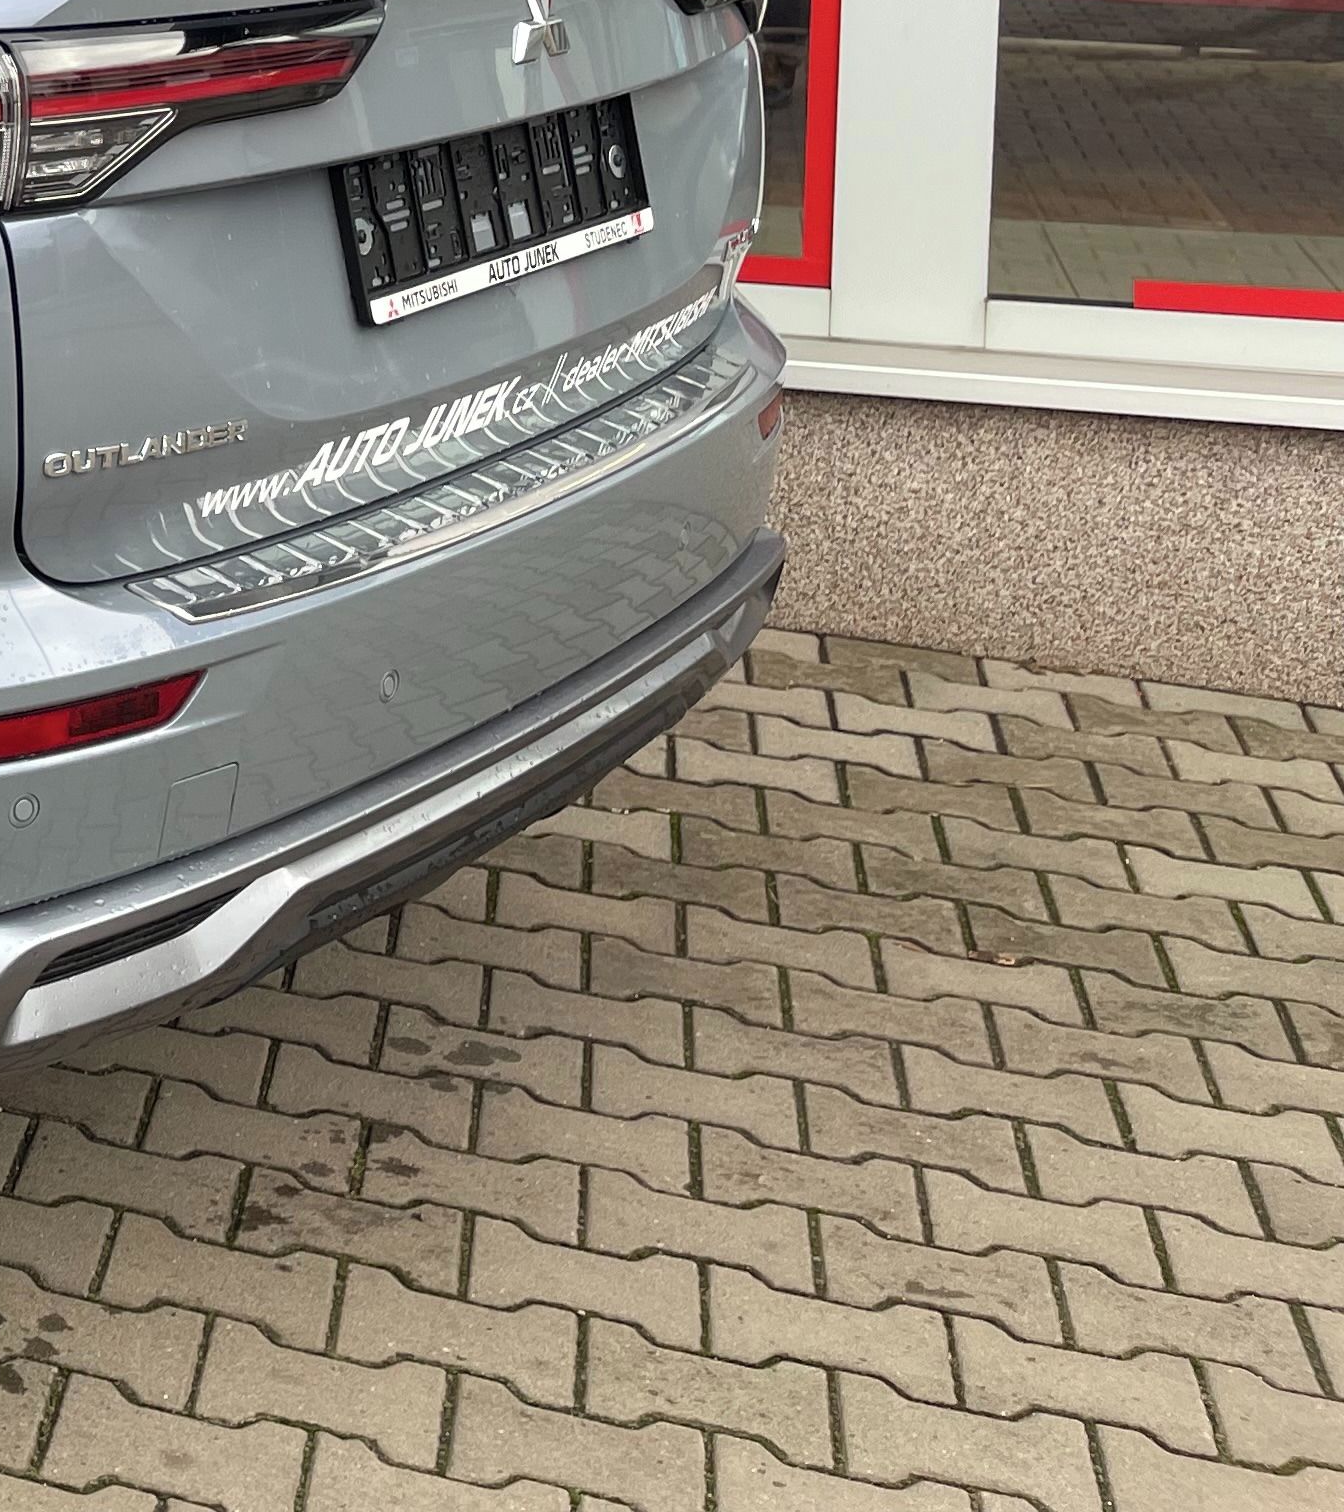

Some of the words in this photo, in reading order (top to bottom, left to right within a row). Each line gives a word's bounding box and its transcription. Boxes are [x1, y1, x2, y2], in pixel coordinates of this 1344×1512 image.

[401, 279, 459, 310] MITSUBISHI
[488, 254, 521, 284] AUTO
[524, 241, 560, 272] JUNEK
[584, 221, 628, 249] STUDENEC
[563, 344, 628, 392] dealer
[625, 285, 717, 362] MITSUBISHI
[43, 419, 249, 478] OUTLANDER
